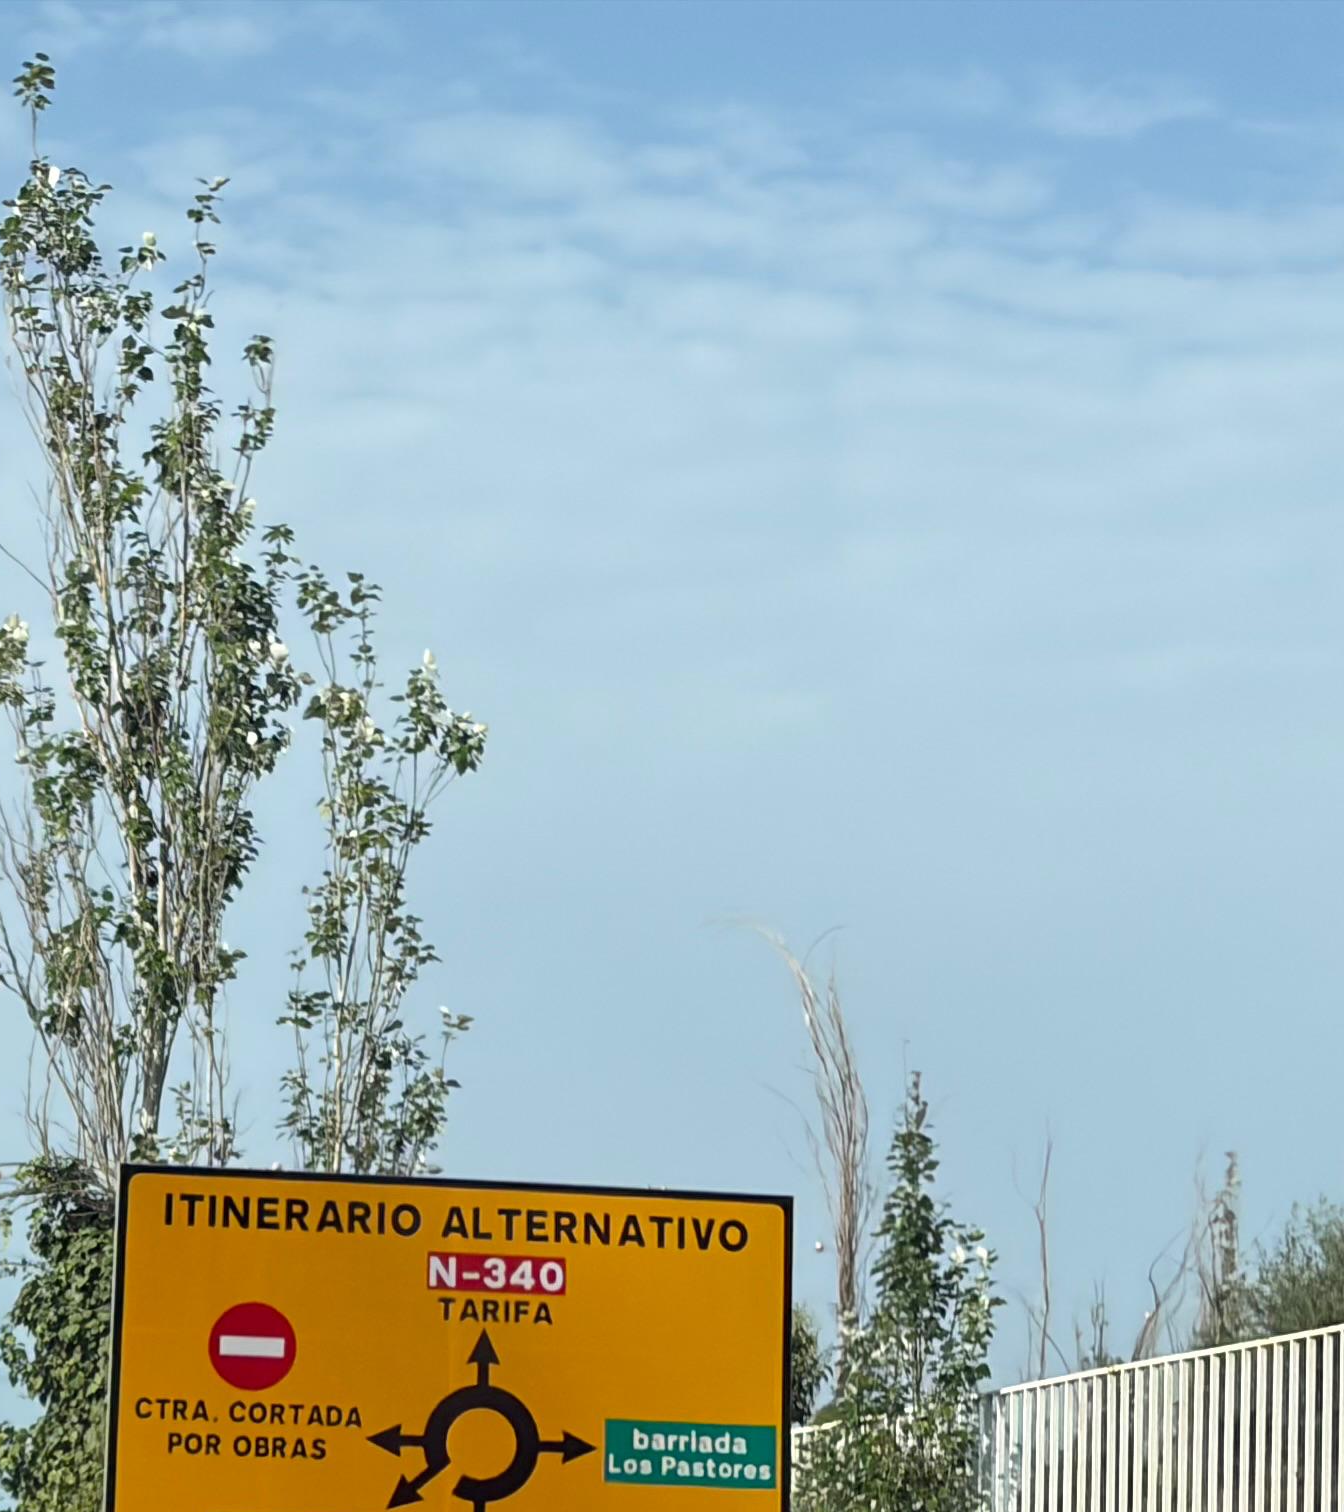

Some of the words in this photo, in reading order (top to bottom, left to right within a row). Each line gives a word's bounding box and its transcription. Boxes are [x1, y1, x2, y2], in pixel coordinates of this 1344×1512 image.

[163, 1193, 422, 1237] ITINERARIO
[441, 1206, 749, 1252] ALTERNATIVO
[427, 1255, 565, 1292] N-340
[438, 1298, 554, 1325] TARIFA
[134, 1397, 219, 1423] CTRA.
[228, 1401, 362, 1428] CORTADA
[167, 1432, 221, 1455] POR
[232, 1436, 327, 1460] OBRAS
[608, 1453, 653, 1475] Los
[661, 1456, 771, 1480] Pastores
